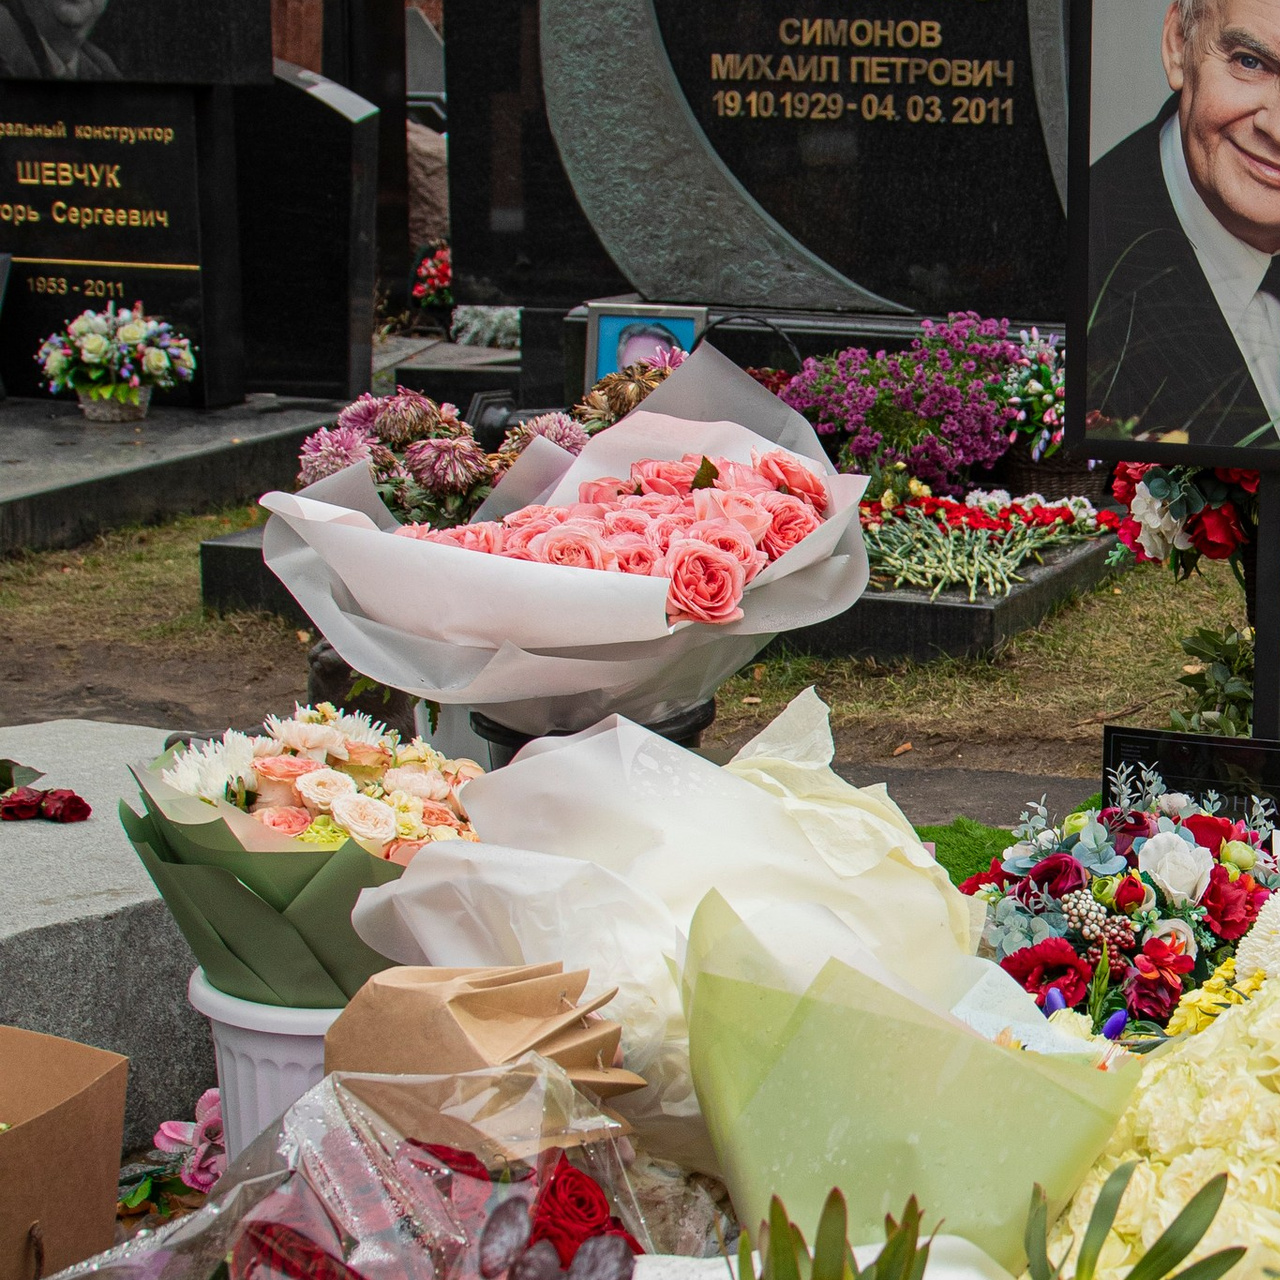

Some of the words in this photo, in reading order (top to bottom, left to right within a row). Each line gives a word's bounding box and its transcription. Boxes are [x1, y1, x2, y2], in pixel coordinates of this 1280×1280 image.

[778, 17, 943, 48] СИМОНОВ
[710, 53, 840, 83] МИХАИЛ
[850, 56, 1015, 87] ПЕТРОВИЧ
[74, 124, 175, 145] конструктор
[16, 160, 122, 189] ШЕВЧУК
[0, 203, 41, 226] орь
[51, 200, 170, 229] Сергеевич
[27, 276, 68, 296] 1953
[83, 278, 125, 298] 2011
